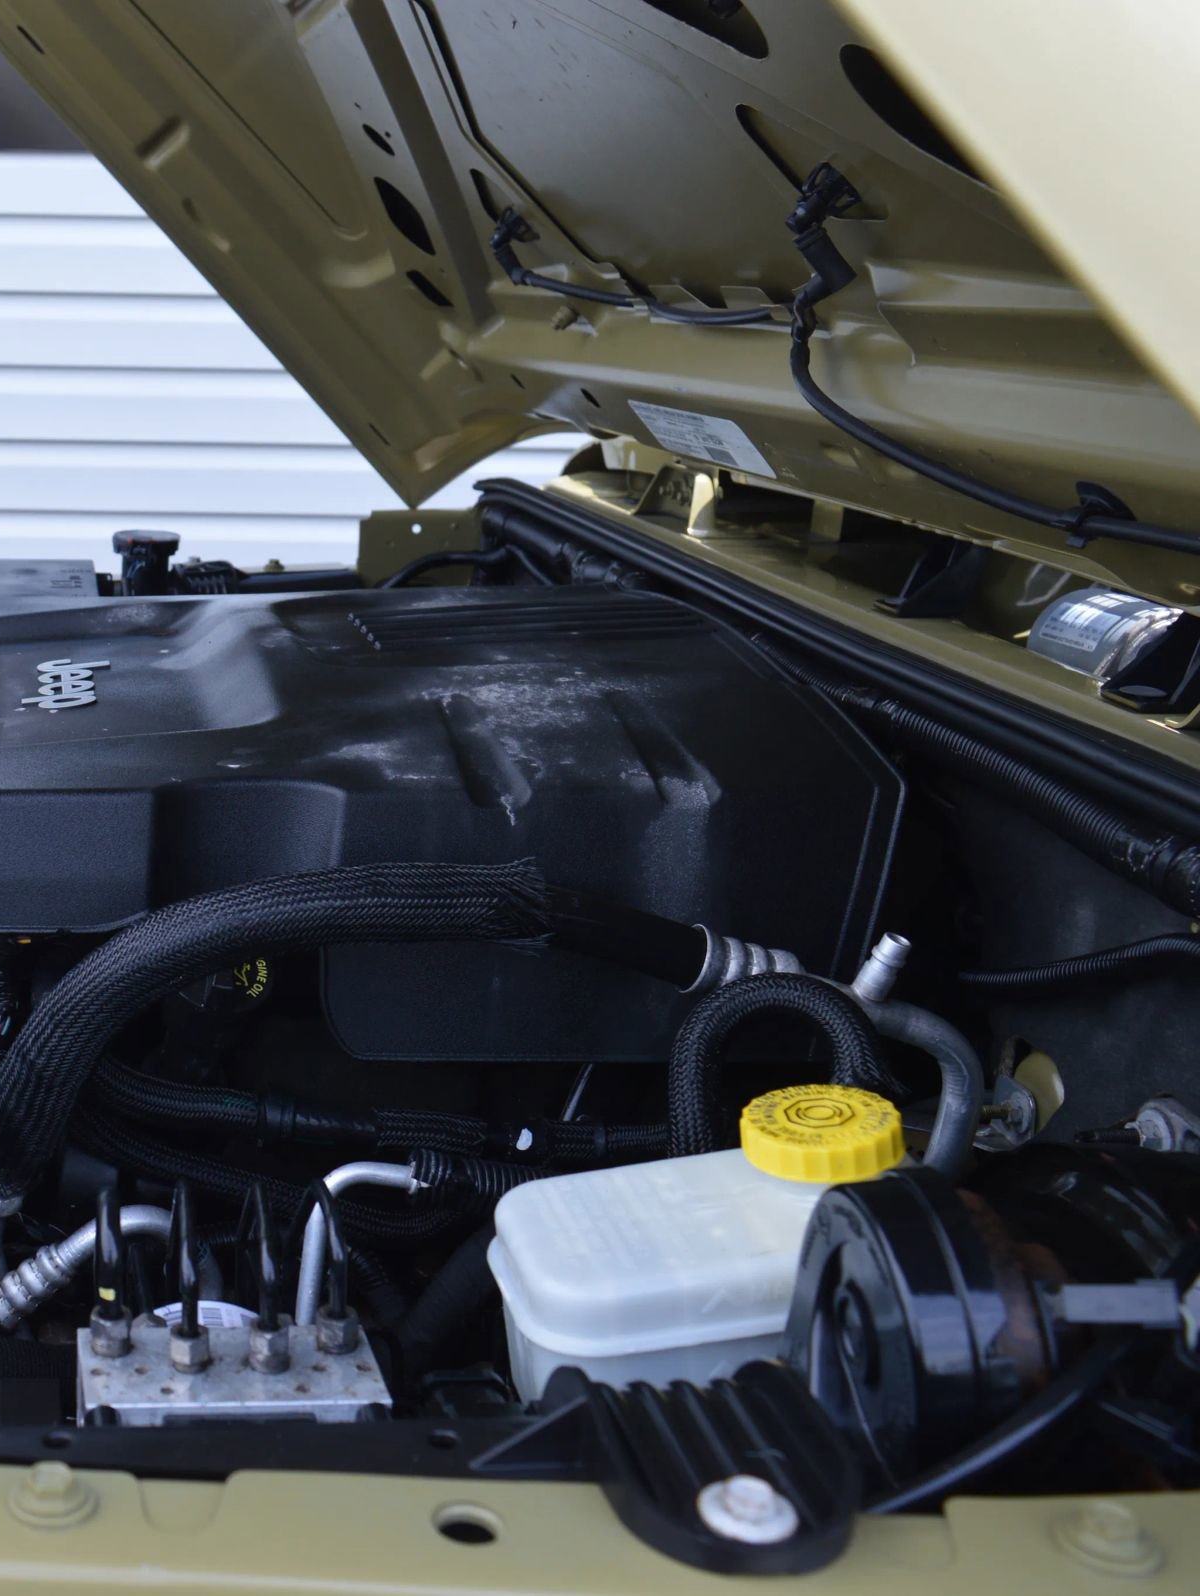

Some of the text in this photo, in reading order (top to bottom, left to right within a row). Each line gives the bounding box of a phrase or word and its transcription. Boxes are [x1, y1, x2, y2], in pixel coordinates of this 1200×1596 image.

[20, 658, 111, 711] Jeep
[246, 959, 268, 998] GINE OIL
